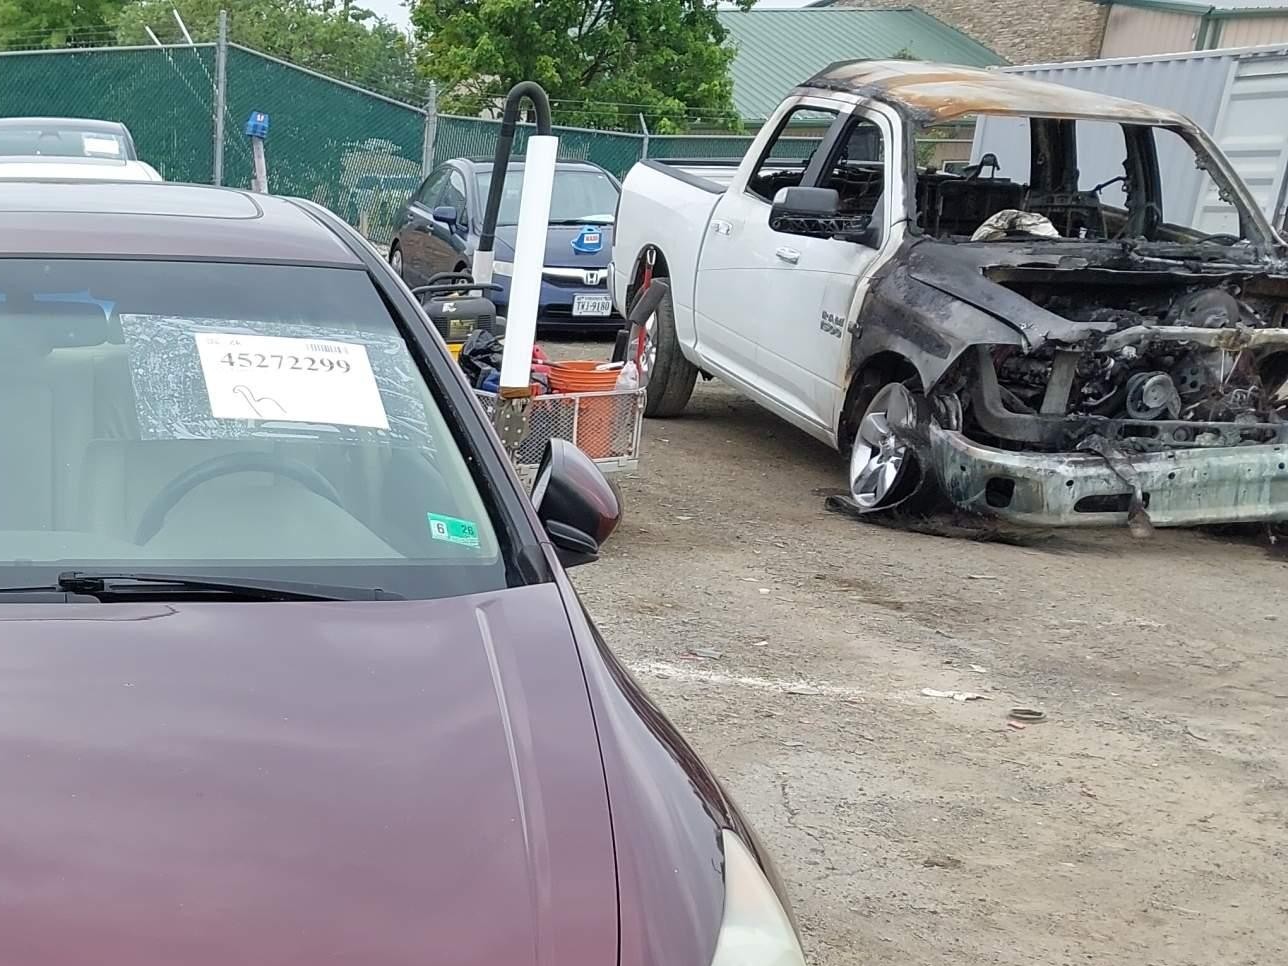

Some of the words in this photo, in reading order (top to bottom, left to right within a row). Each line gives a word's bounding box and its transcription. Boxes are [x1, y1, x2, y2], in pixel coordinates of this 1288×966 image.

[821, 310, 845, 327] RAM
[220, 352, 352, 374] 45272299
[436, 522, 445, 534] 6
